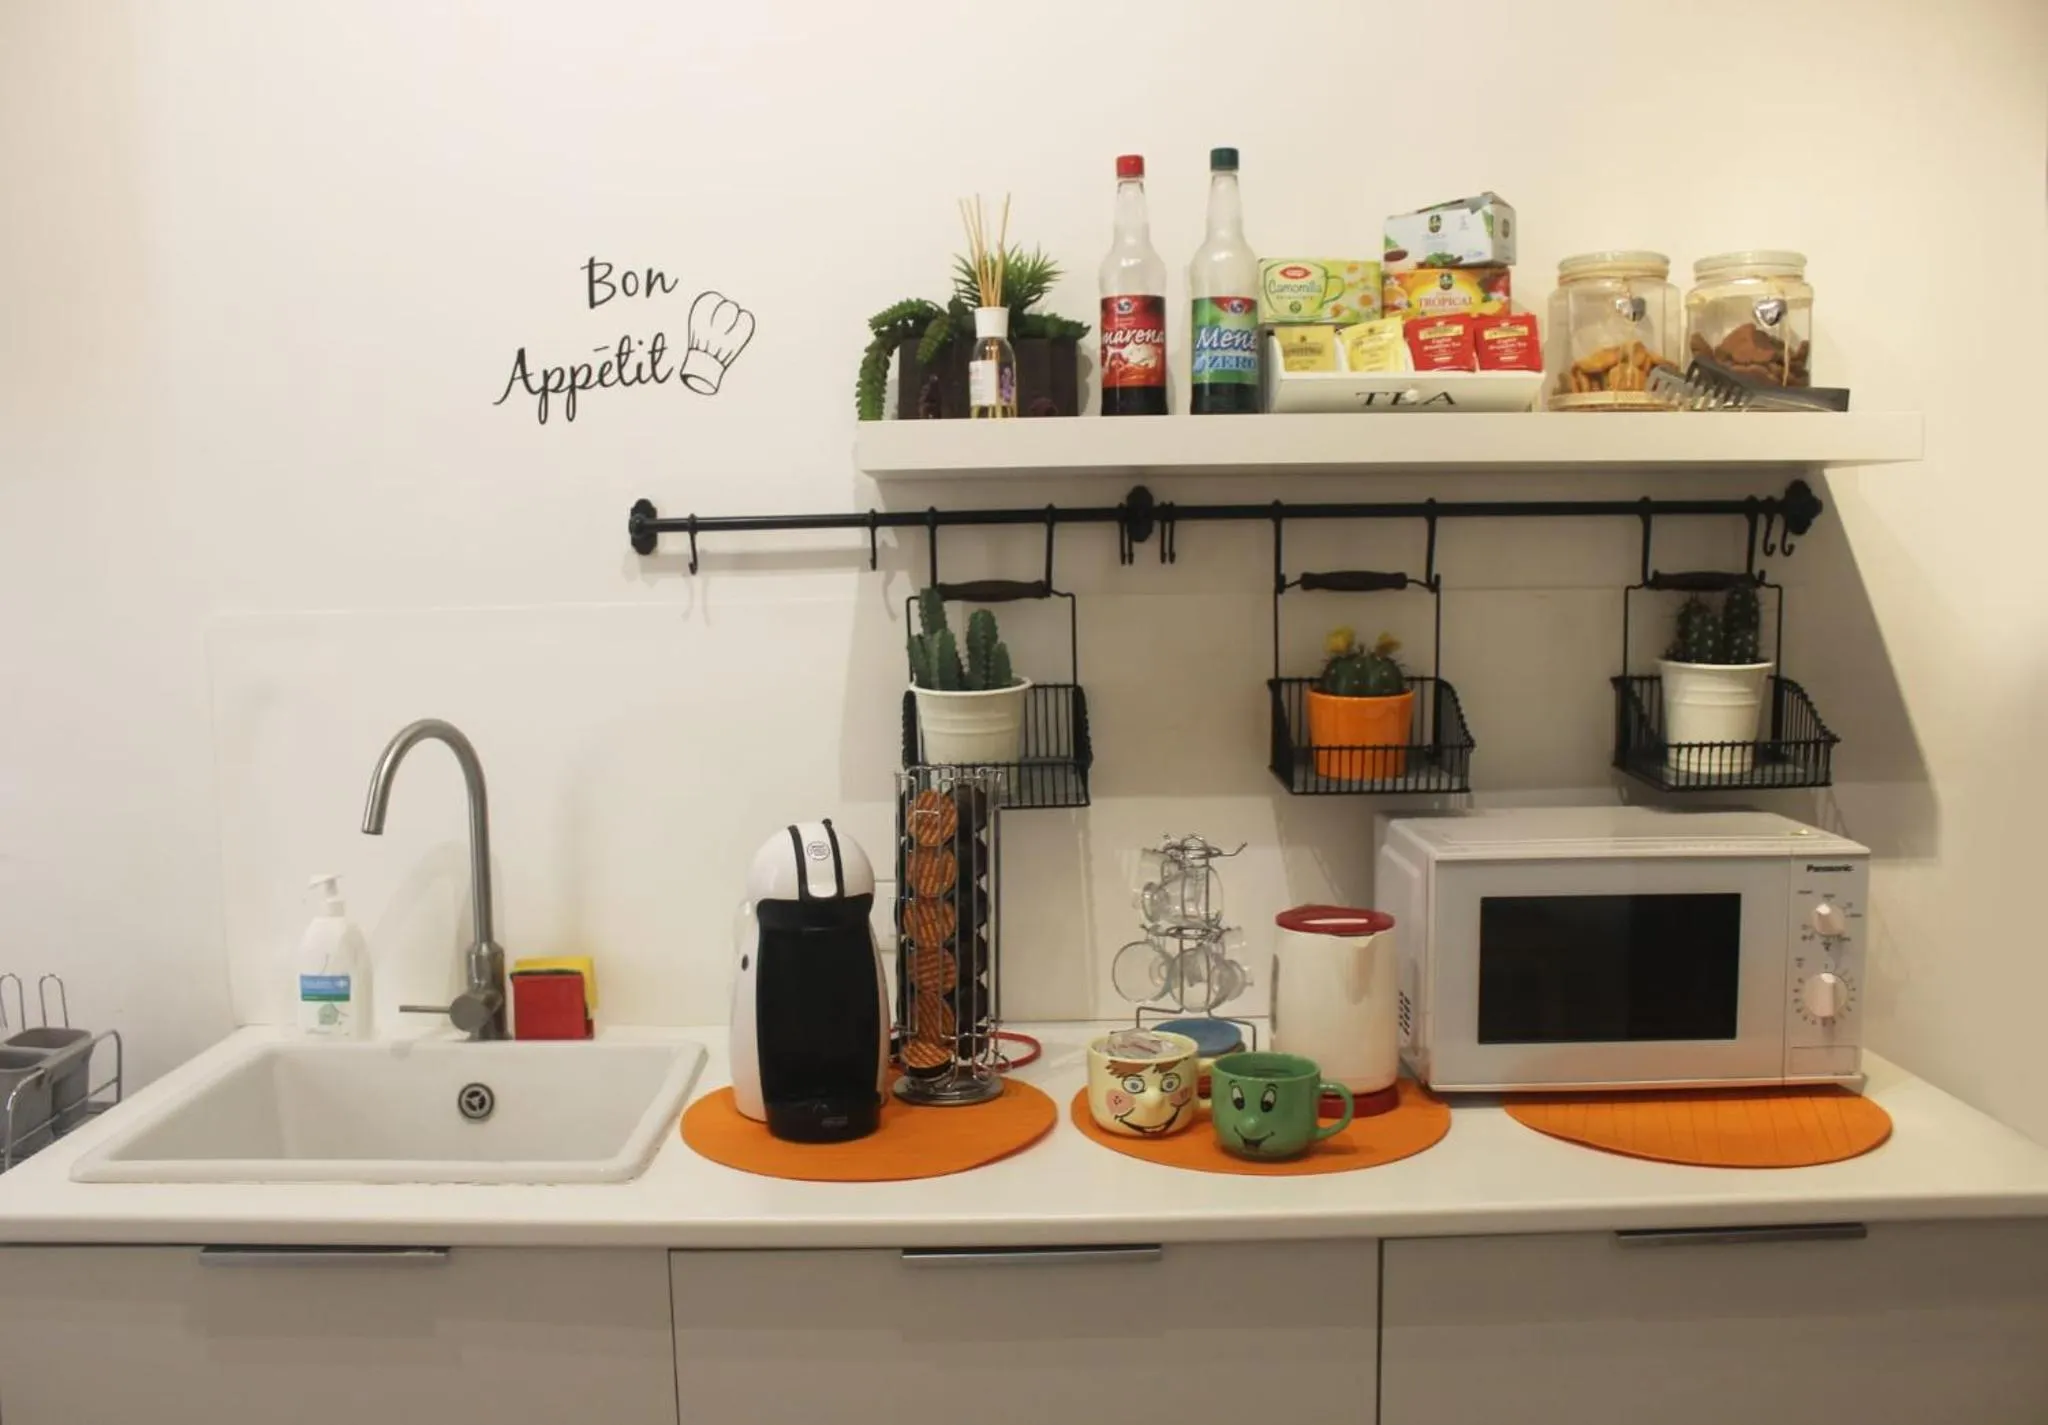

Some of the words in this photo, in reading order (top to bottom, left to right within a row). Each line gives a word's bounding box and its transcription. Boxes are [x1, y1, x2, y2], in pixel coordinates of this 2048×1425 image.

[580, 256, 679, 309] Bon
[1268, 279, 1322, 294] Camomilla
[1417, 296, 1473, 308] TROPICAL
[1355, 391, 1457, 406] TEA
[1806, 863, 1854, 872] Panasonic
